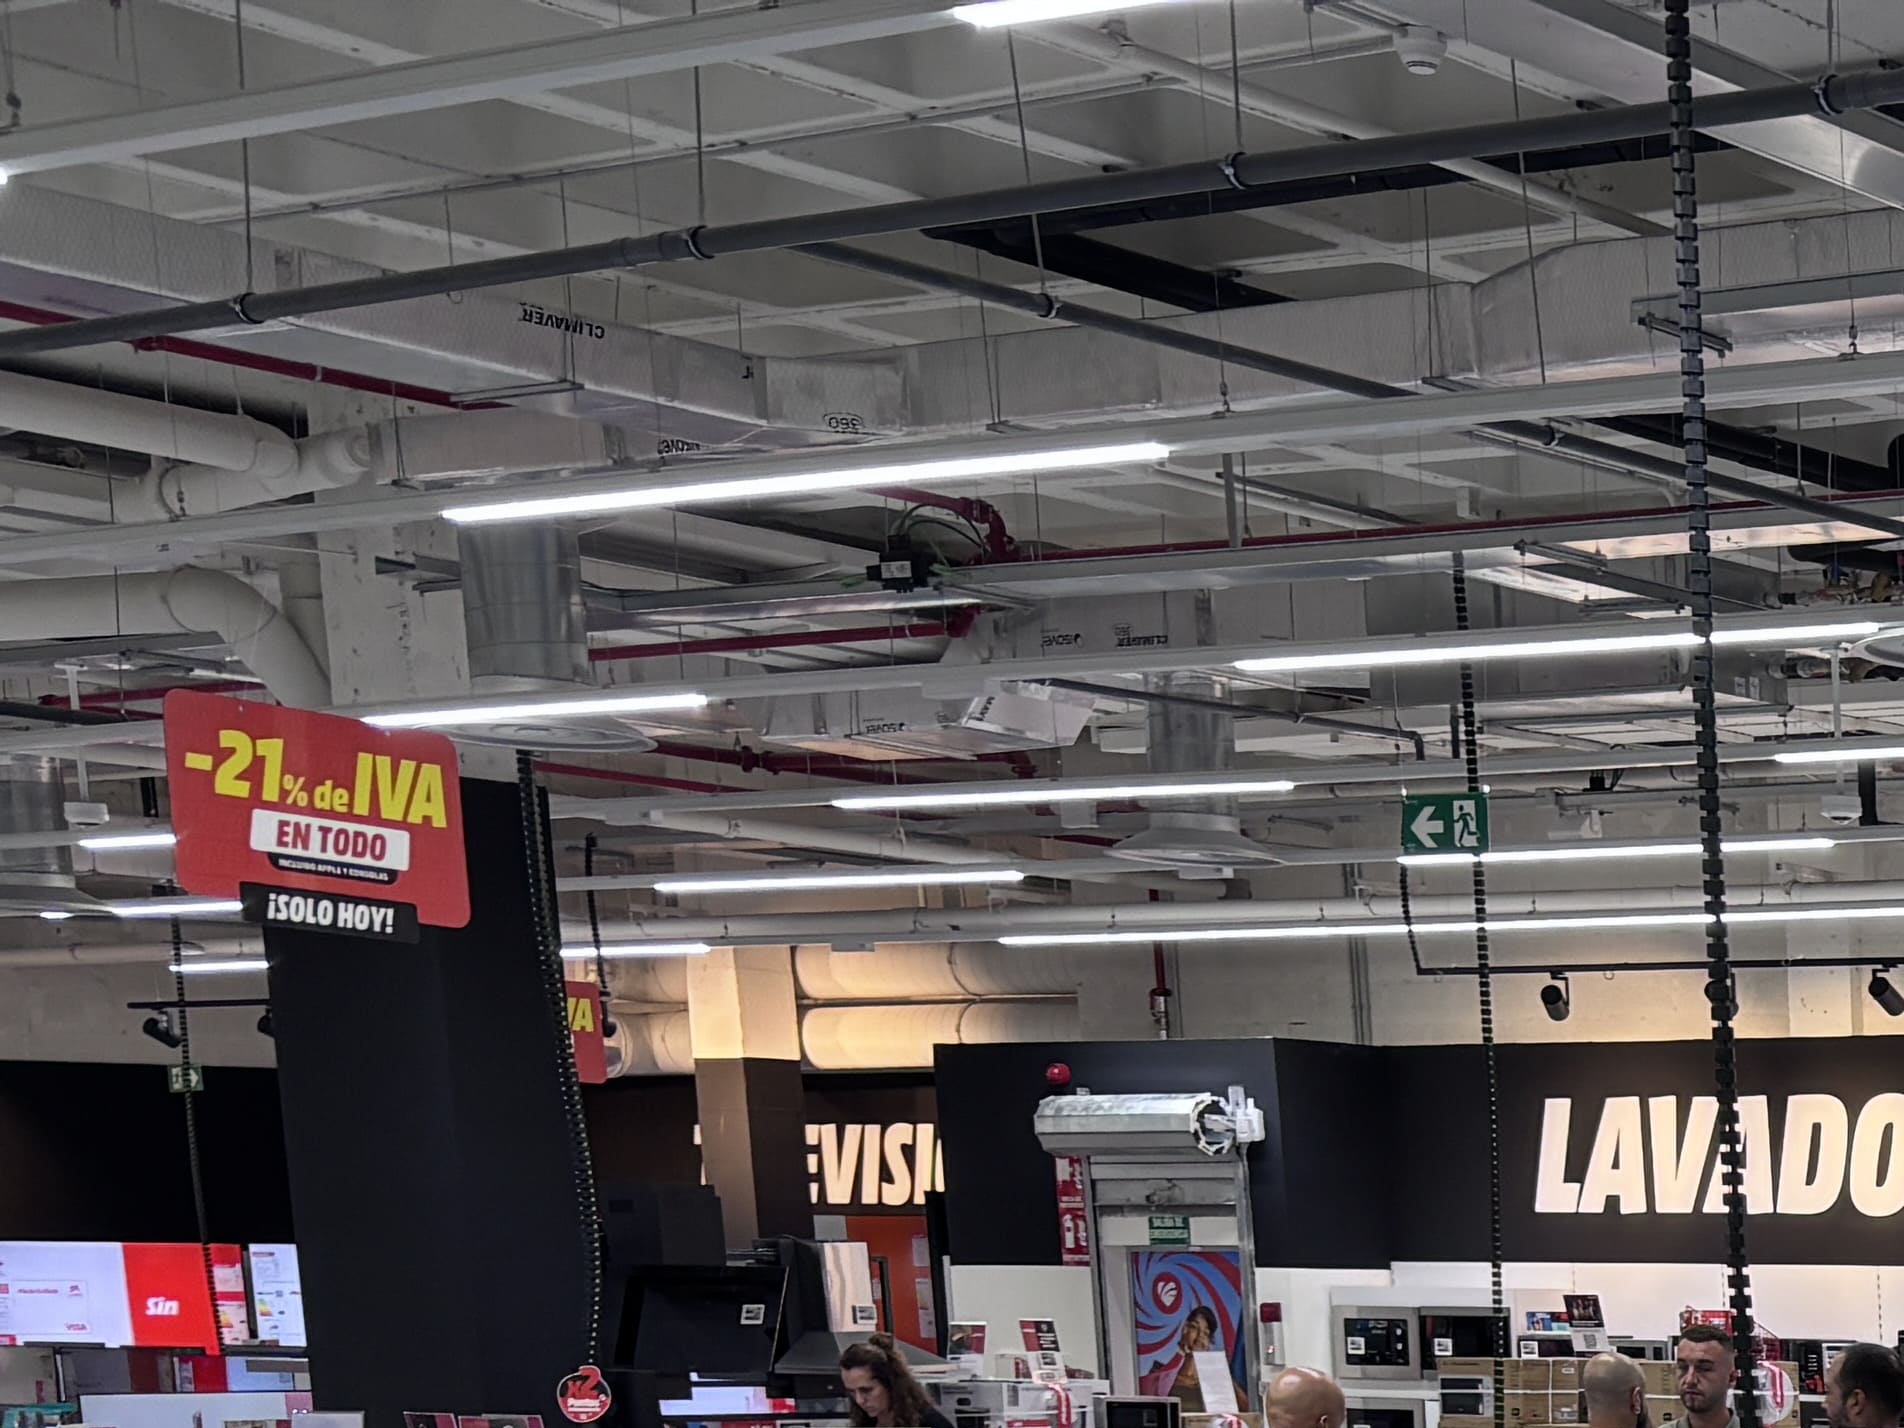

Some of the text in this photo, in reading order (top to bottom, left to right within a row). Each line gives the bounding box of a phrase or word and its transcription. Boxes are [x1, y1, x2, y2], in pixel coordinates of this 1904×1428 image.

[313, 780, 350, 813] de
[353, 752, 447, 828] IVA
[276, 819, 387, 861] EN TODO
[268, 893, 394, 933] ¡SOLO HOY!
[145, 1297, 180, 1317] Sin
